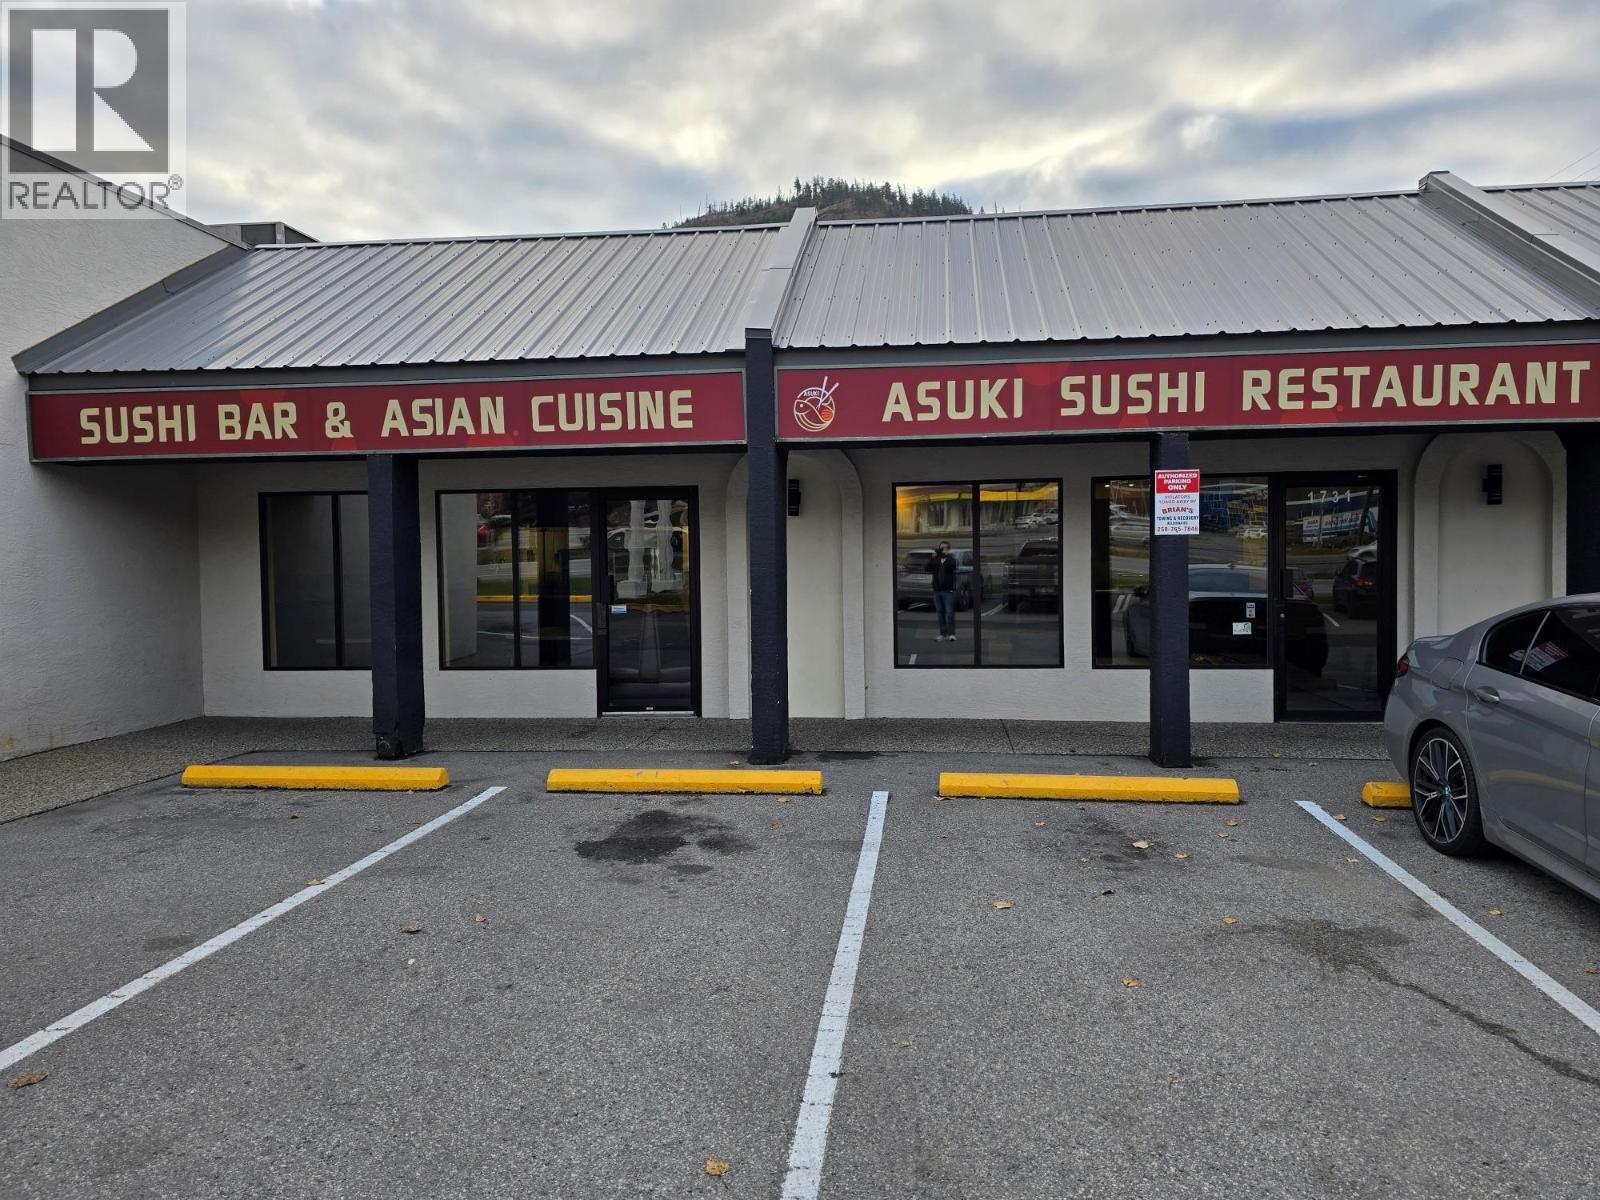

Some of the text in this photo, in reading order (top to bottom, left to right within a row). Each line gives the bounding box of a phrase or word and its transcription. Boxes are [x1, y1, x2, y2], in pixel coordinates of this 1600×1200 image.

[881, 360, 1591, 423] ASUKI SUSHI RESTAURANT
[79, 389, 694, 446] SUSHI BAR & ASIAN CUISINE
[1161, 506, 1194, 515] BRIAN'S
[1307, 489, 1351, 503] 1731
